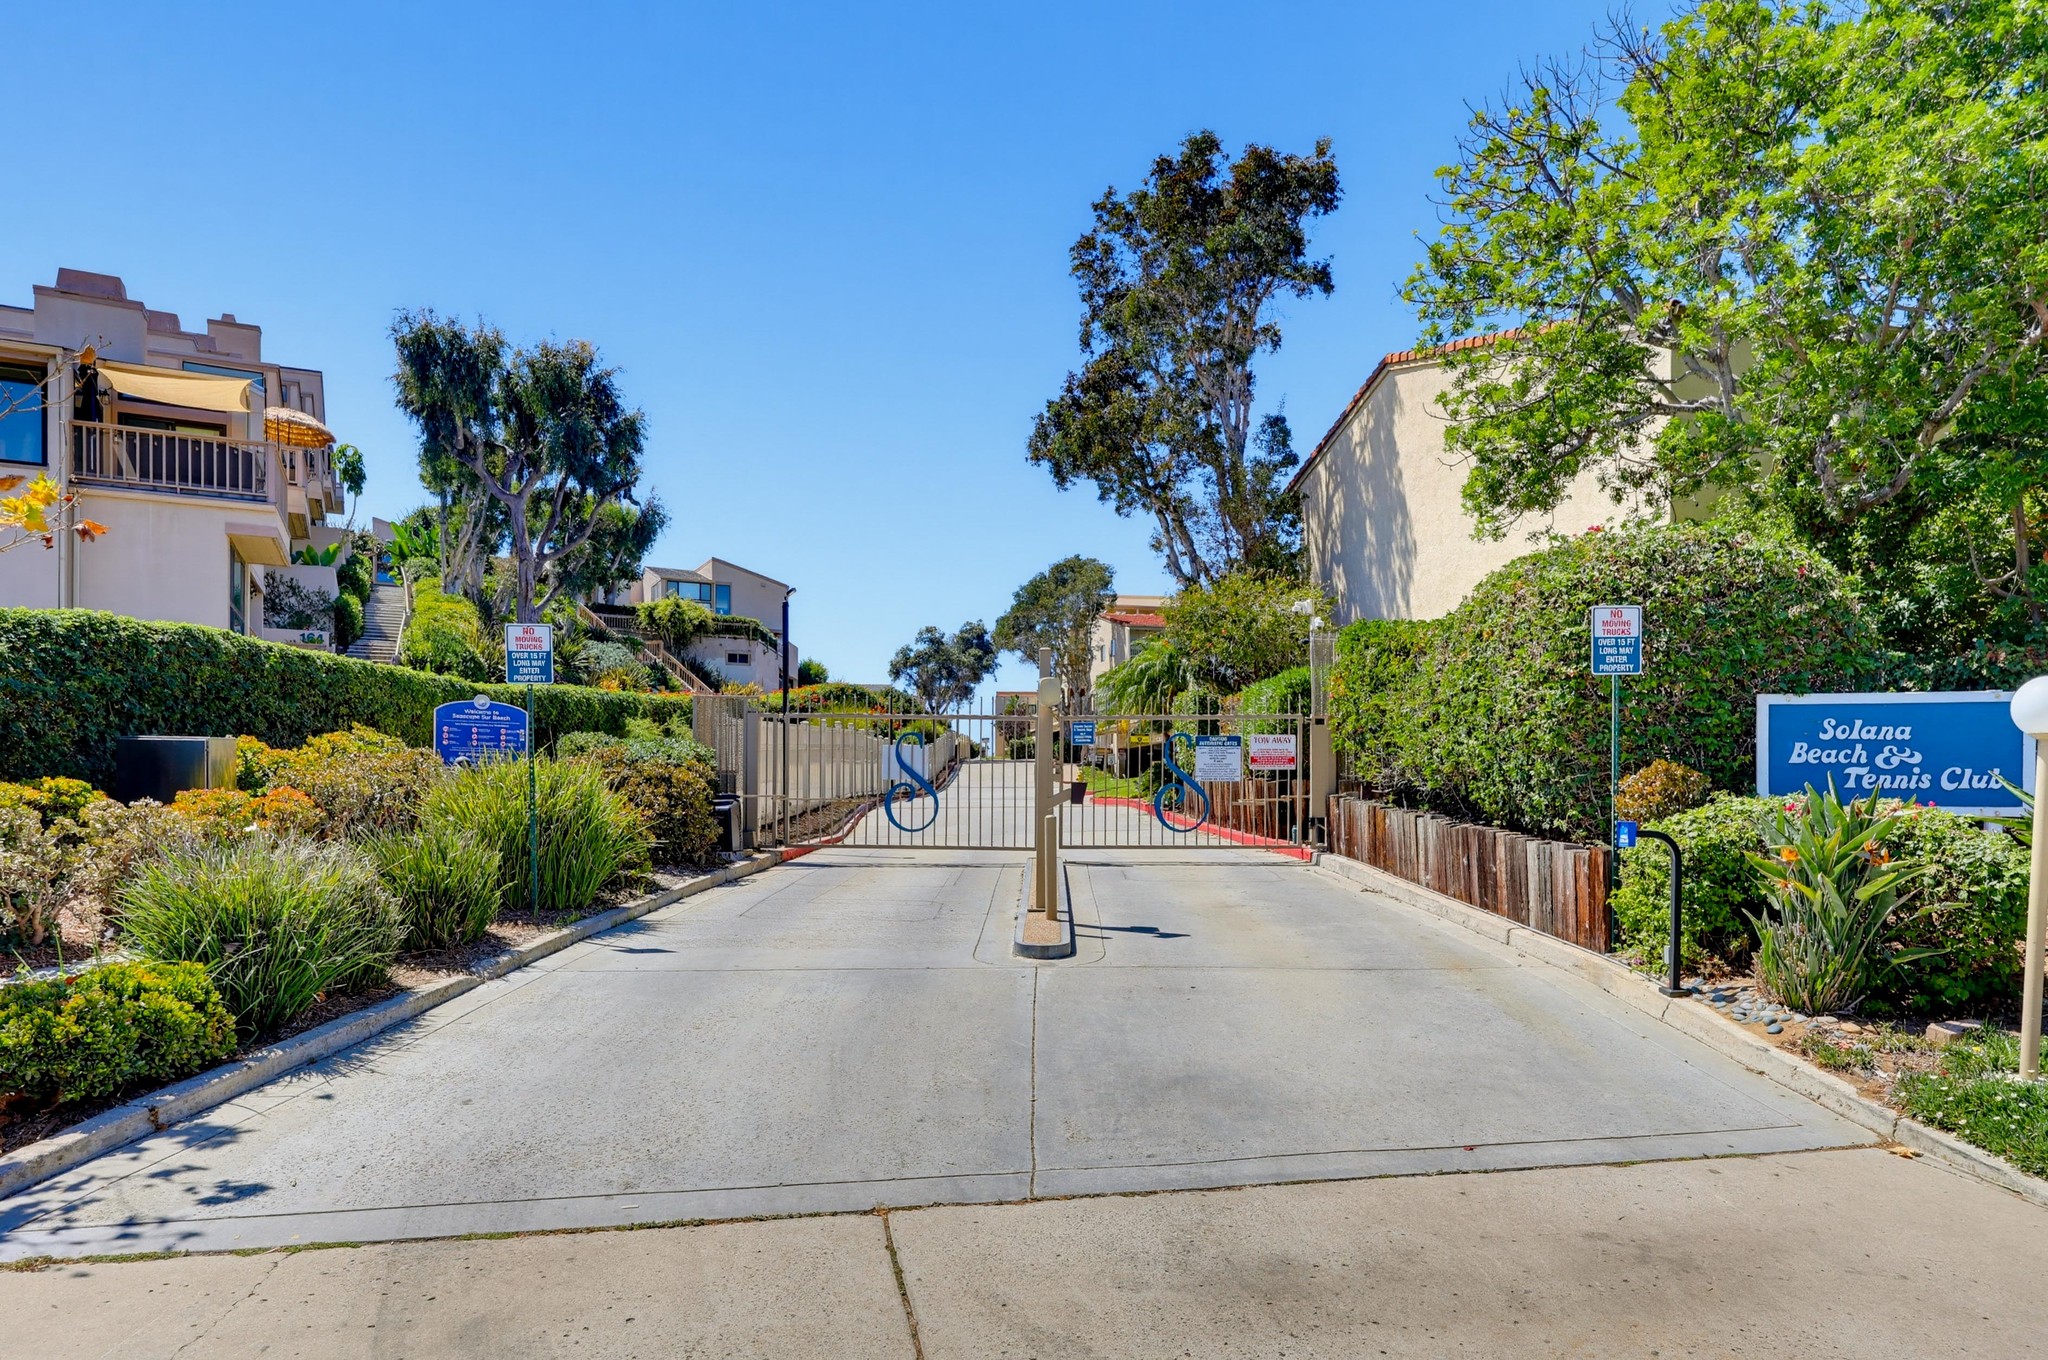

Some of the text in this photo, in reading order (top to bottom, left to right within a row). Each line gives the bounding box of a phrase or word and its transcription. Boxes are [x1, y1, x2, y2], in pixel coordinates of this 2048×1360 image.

[1610, 610, 1623, 618] NO
[1818, 718, 1912, 740] Solana
[1788, 742, 1923, 770] Beach &
[1843, 766, 2004, 791] Tennis Club
